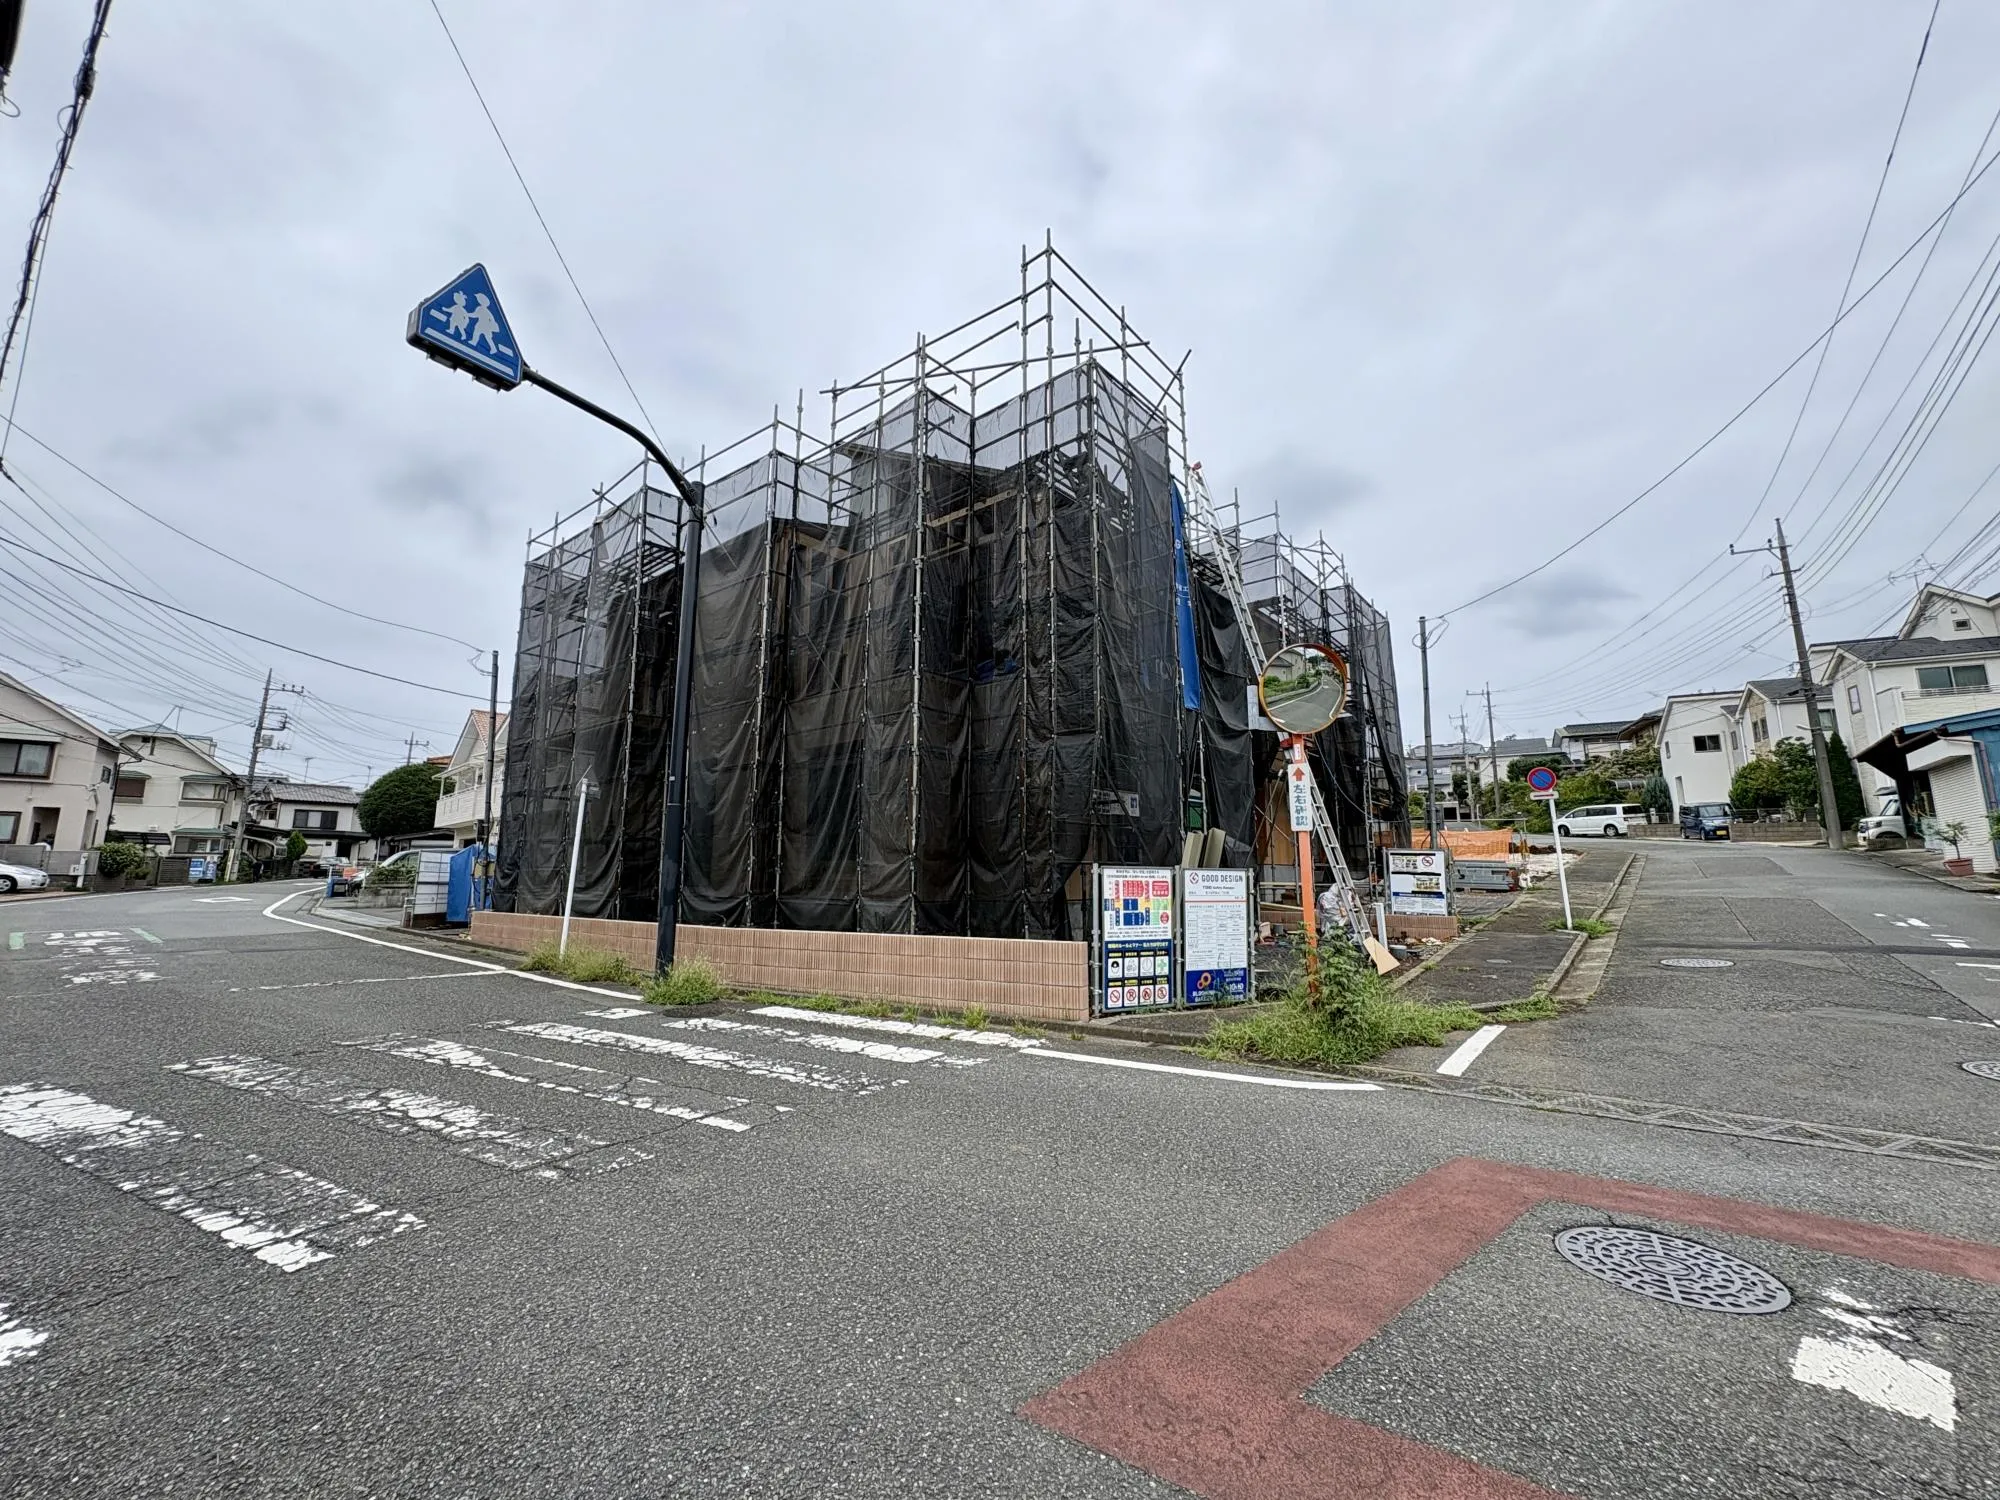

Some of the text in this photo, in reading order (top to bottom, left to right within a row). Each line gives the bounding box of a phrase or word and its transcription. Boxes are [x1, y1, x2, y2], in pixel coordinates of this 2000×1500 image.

[1293, 784, 1308, 826] 左右確認
[1201, 874, 1243, 883] GOOD DESIGN
